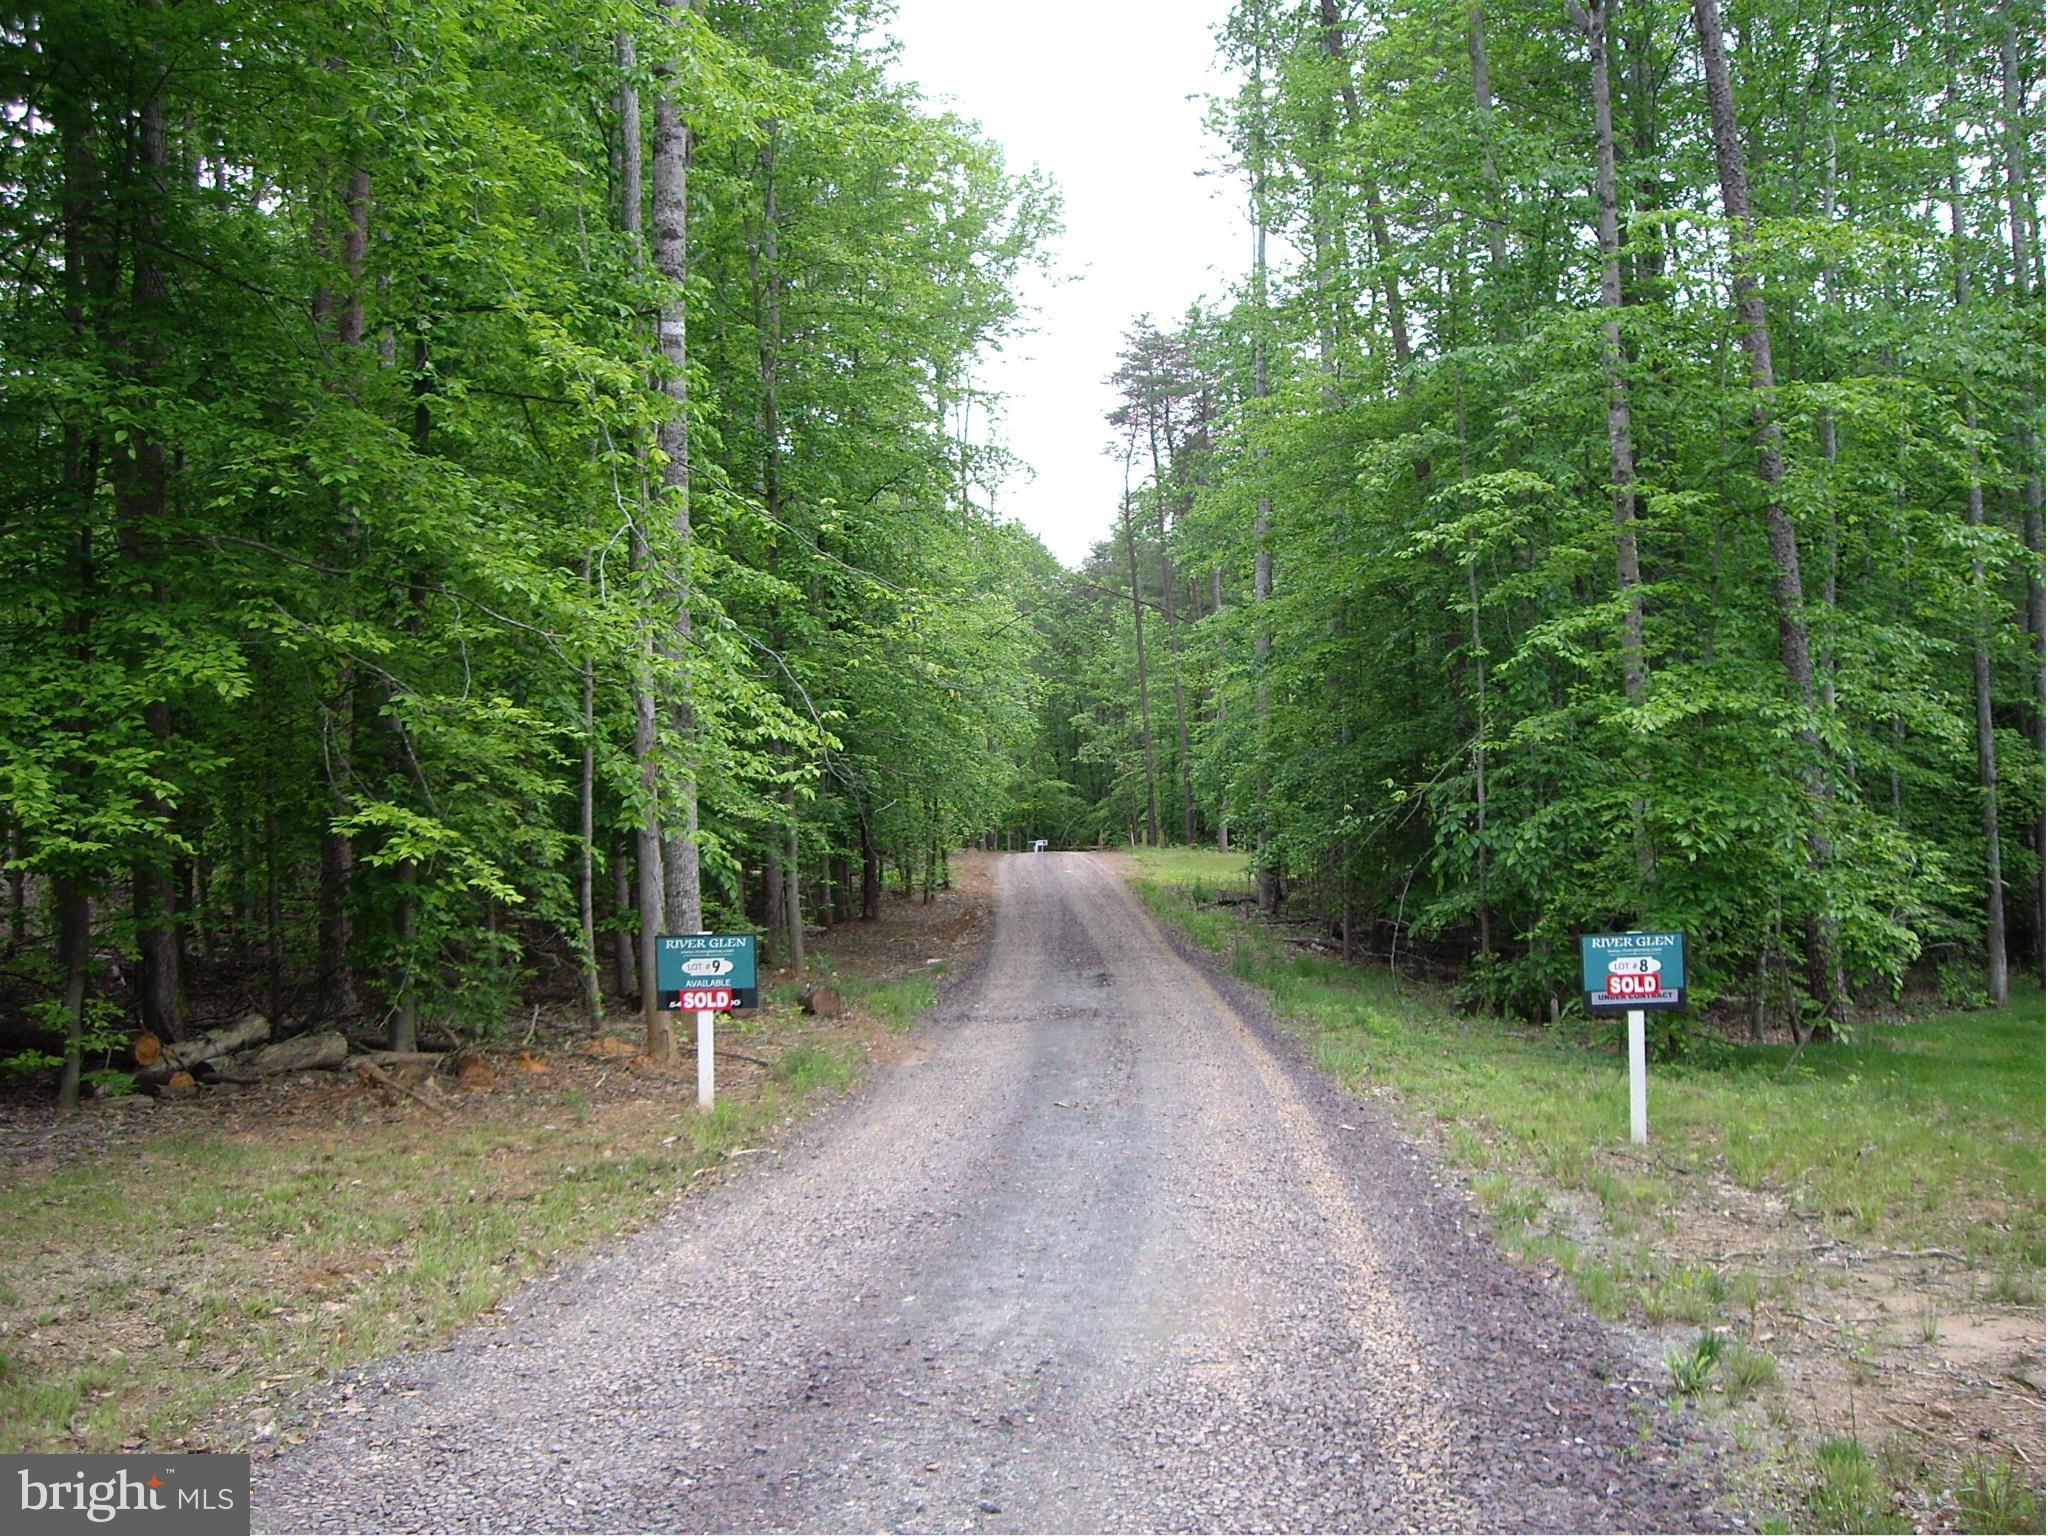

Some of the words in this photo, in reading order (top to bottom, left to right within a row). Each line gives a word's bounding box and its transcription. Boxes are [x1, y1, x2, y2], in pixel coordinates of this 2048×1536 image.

[665, 939, 706, 949] RIVER
[709, 937, 747, 948] GLEN
[1592, 937, 1633, 948] RIVER
[1636, 935, 1675, 947] GLEN
[687, 963, 702, 971] LOT
[685, 979, 731, 987] AVAILABLE
[1610, 975, 1656, 993] SOLD
[683, 992, 729, 1009] SOLD
